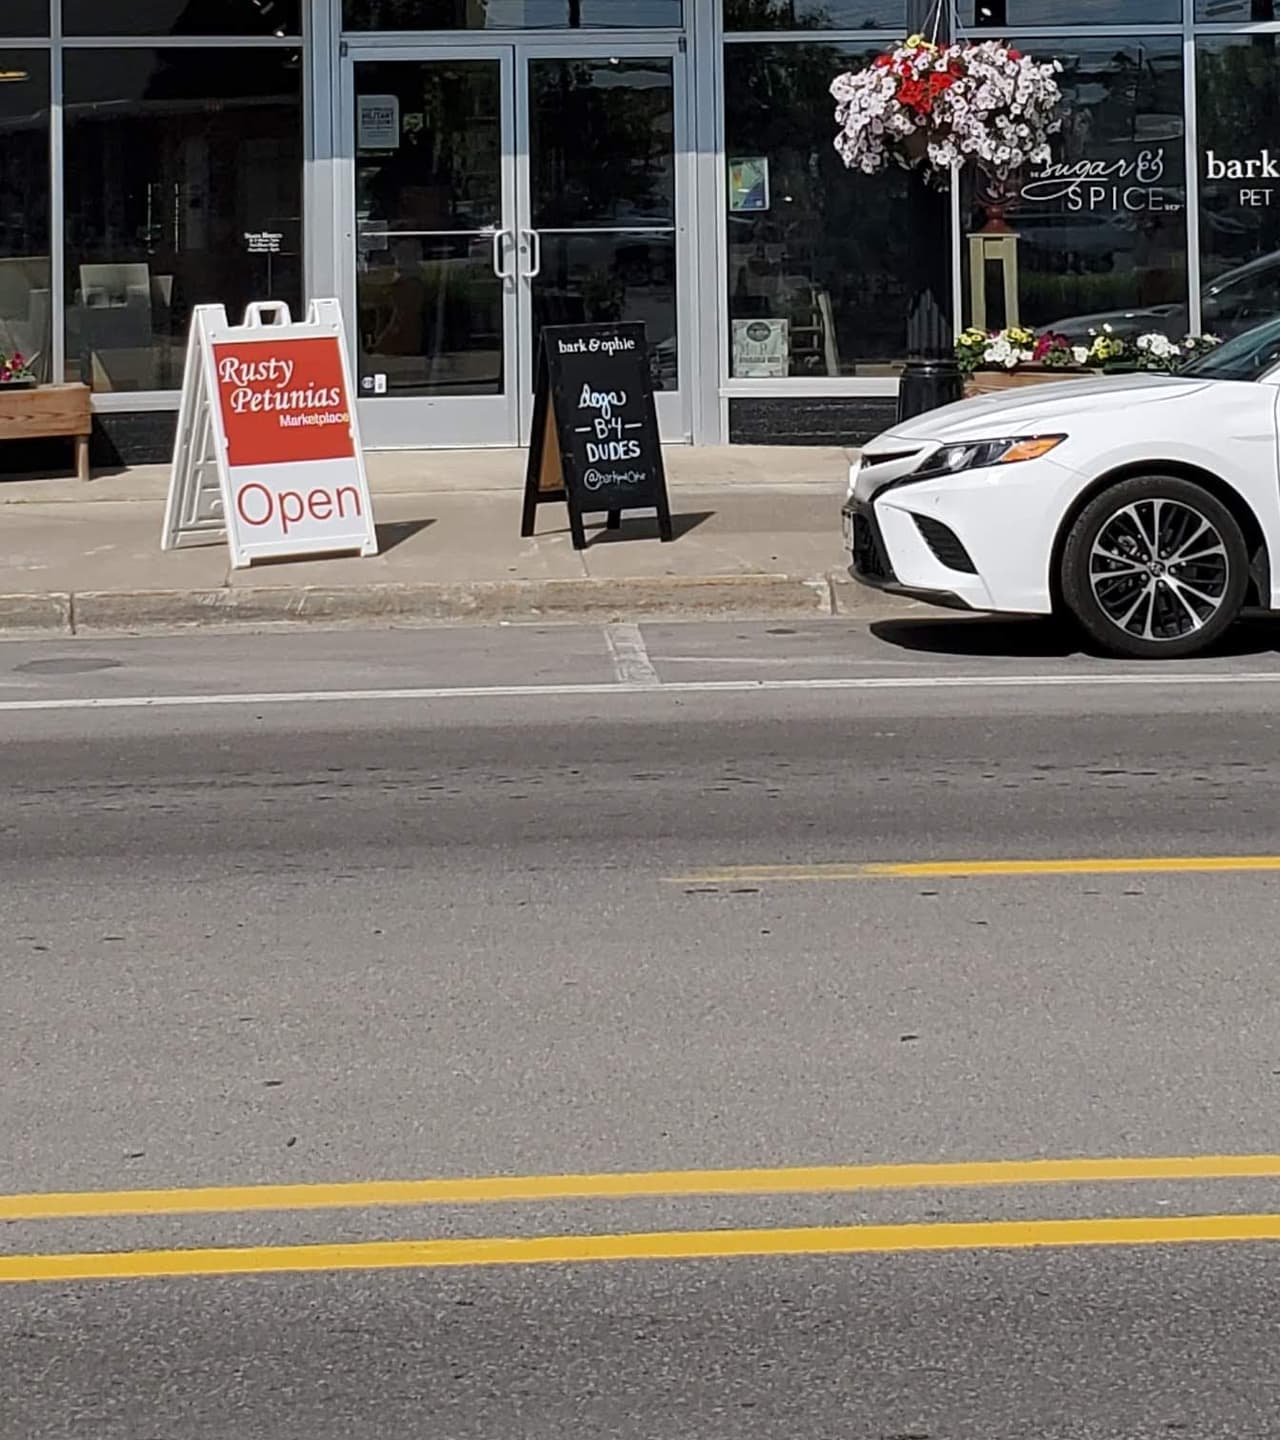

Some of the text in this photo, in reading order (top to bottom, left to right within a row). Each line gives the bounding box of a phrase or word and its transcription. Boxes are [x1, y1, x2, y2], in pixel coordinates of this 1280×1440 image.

[1021, 148, 1163, 200] sugar &
[1206, 149, 1280, 179] bark
[1068, 186, 1163, 210] SPICE
[1240, 189, 1274, 206] PET
[558, 336, 635, 356] bark & ophie
[219, 357, 293, 388] Rusty
[230, 382, 340, 413] Petunias
[279, 411, 349, 427] Marketplace
[586, 440, 641, 463] DUDES
[237, 483, 362, 534] Open
